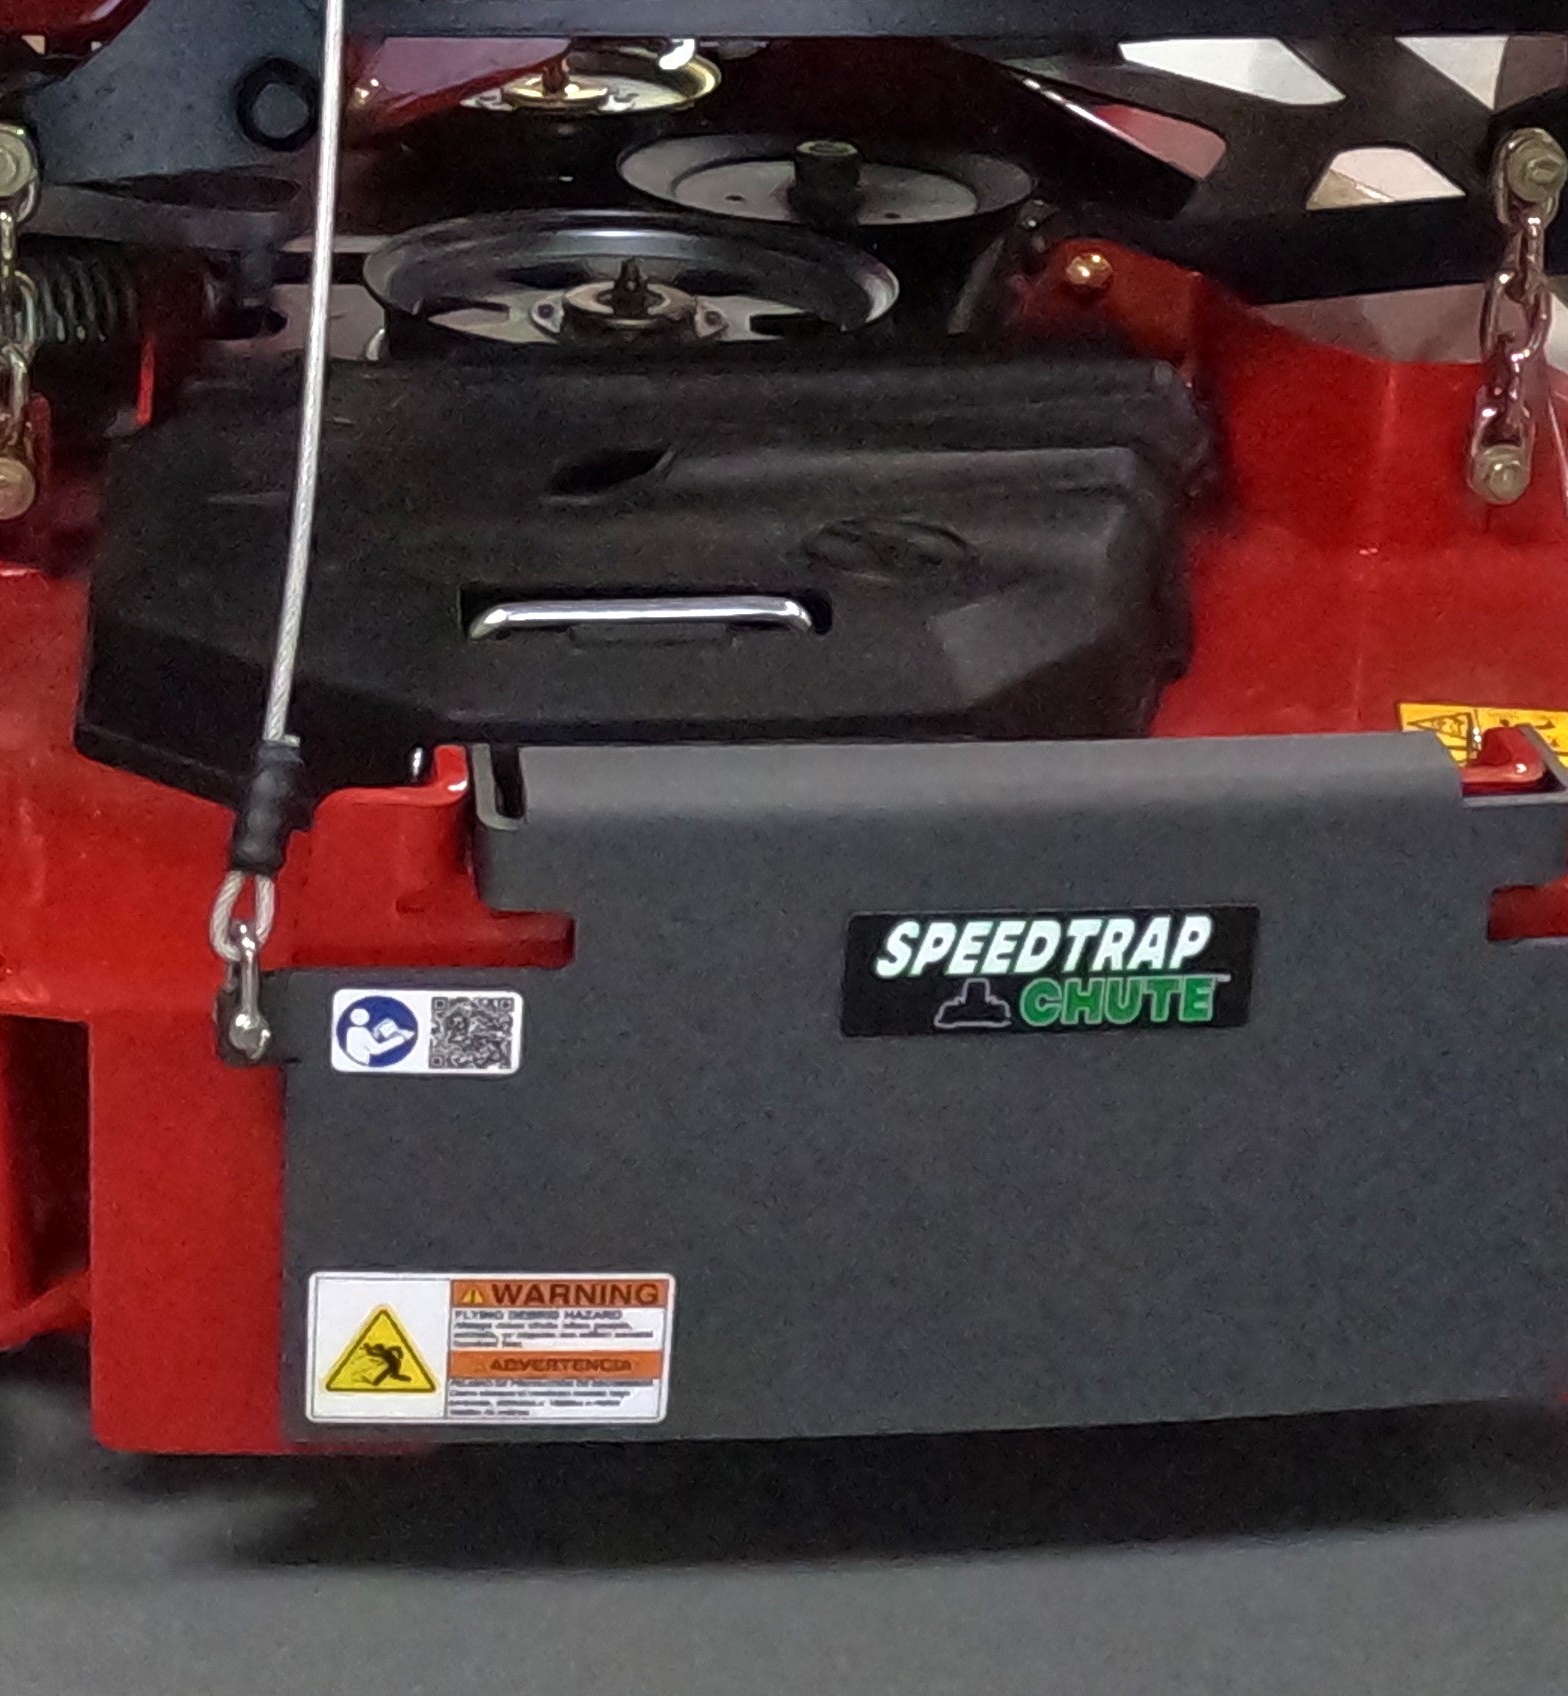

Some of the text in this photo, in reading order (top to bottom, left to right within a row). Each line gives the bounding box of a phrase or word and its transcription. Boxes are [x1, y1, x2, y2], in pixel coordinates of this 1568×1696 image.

[873, 914, 1213, 978] SPEEDTRAP
[1020, 976, 1218, 1025] CHUTE
[491, 1282, 658, 1305] WARNING
